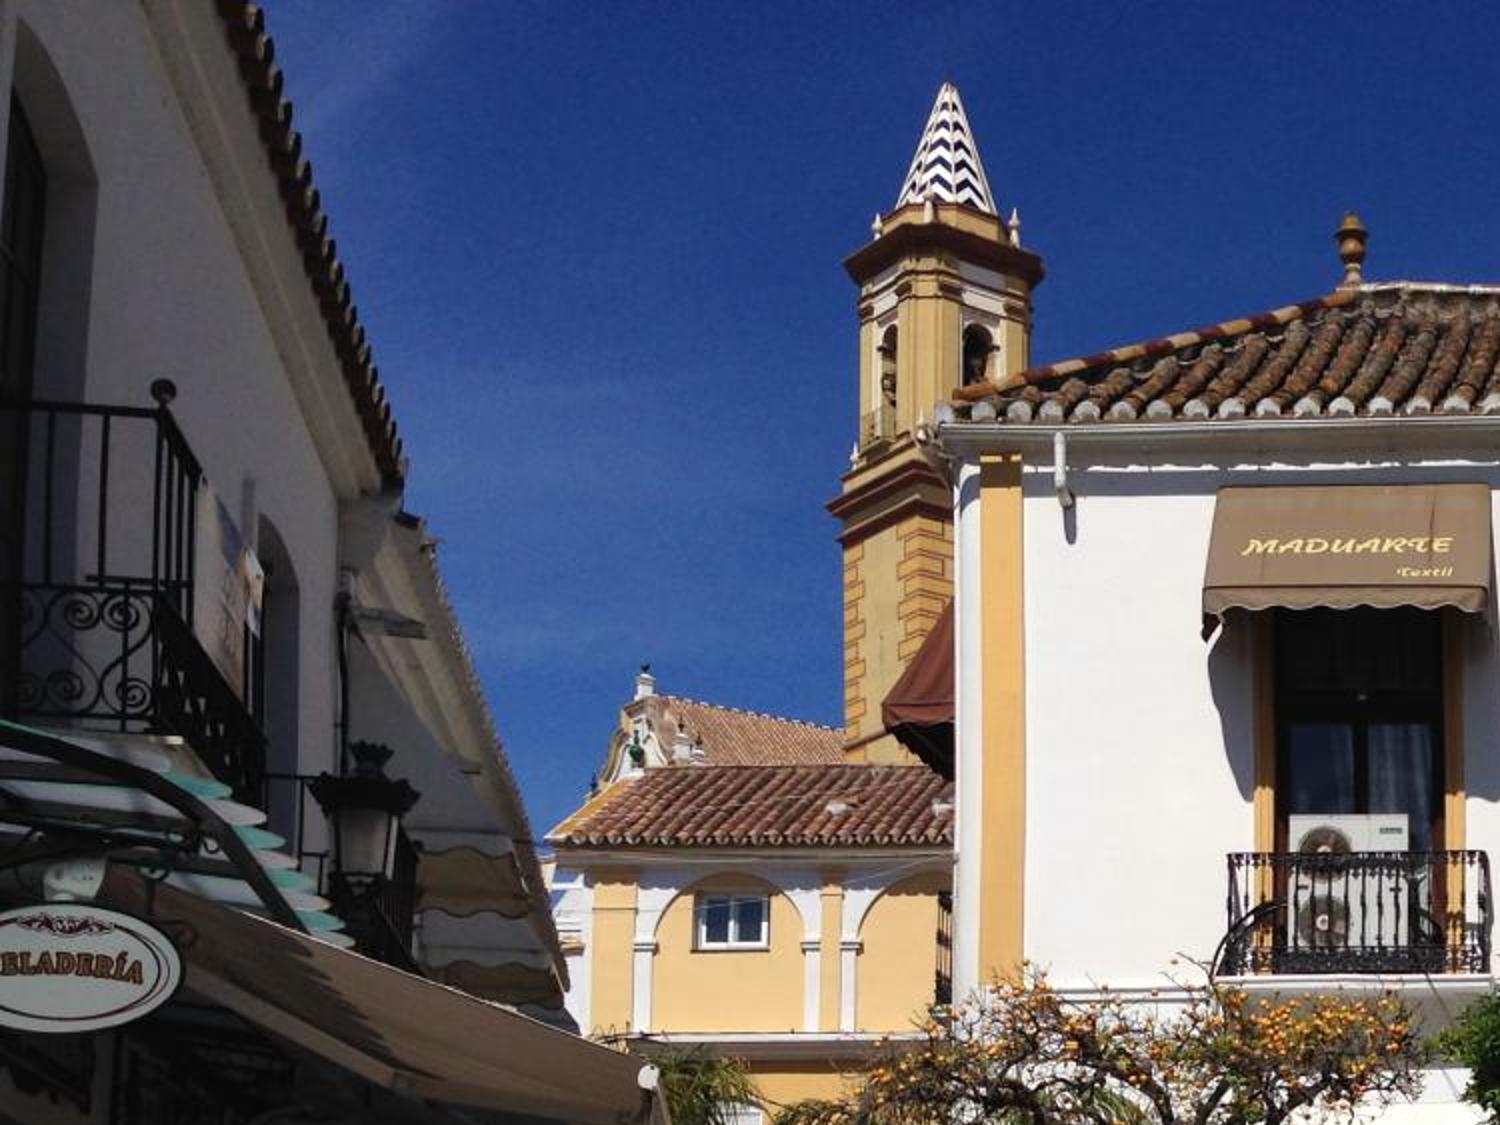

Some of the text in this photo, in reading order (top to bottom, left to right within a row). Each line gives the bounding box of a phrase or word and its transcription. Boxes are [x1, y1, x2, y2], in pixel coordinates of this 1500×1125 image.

[1241, 536, 1455, 557] MADUARTE
[1396, 566, 1453, 578] Textil
[0, 950, 144, 985] ELADERÍA
